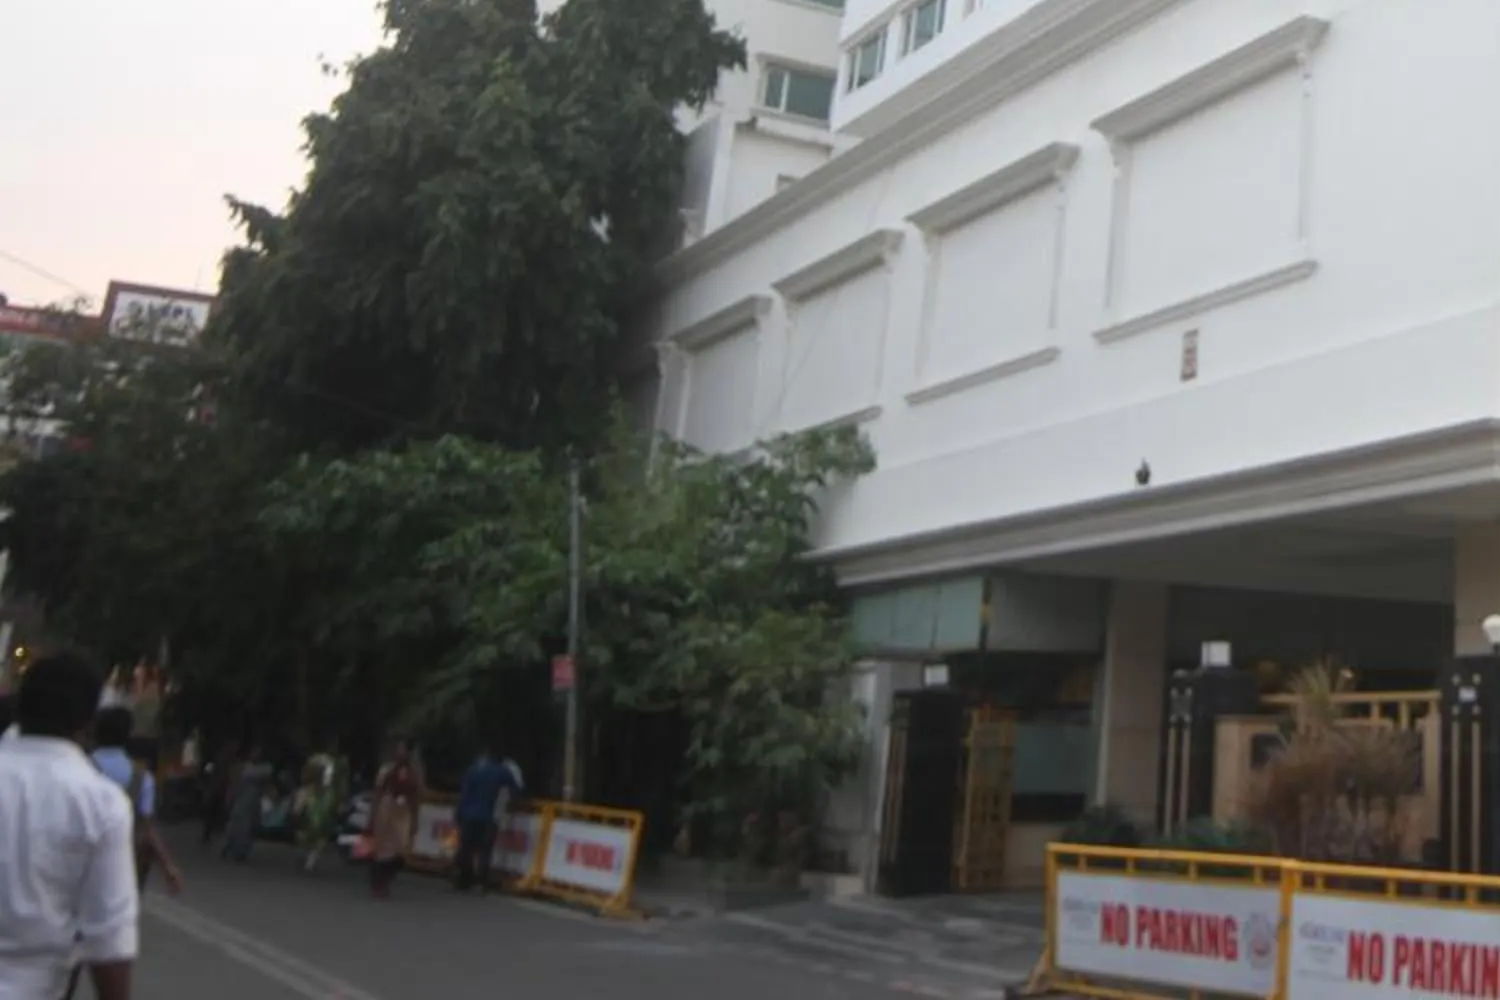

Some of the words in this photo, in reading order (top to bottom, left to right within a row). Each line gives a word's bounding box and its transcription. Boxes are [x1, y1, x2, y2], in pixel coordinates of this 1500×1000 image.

[1100, 903, 1130, 946] NO
[1135, 905, 1240, 961] PARKING
[1347, 931, 1385, 984] NO
